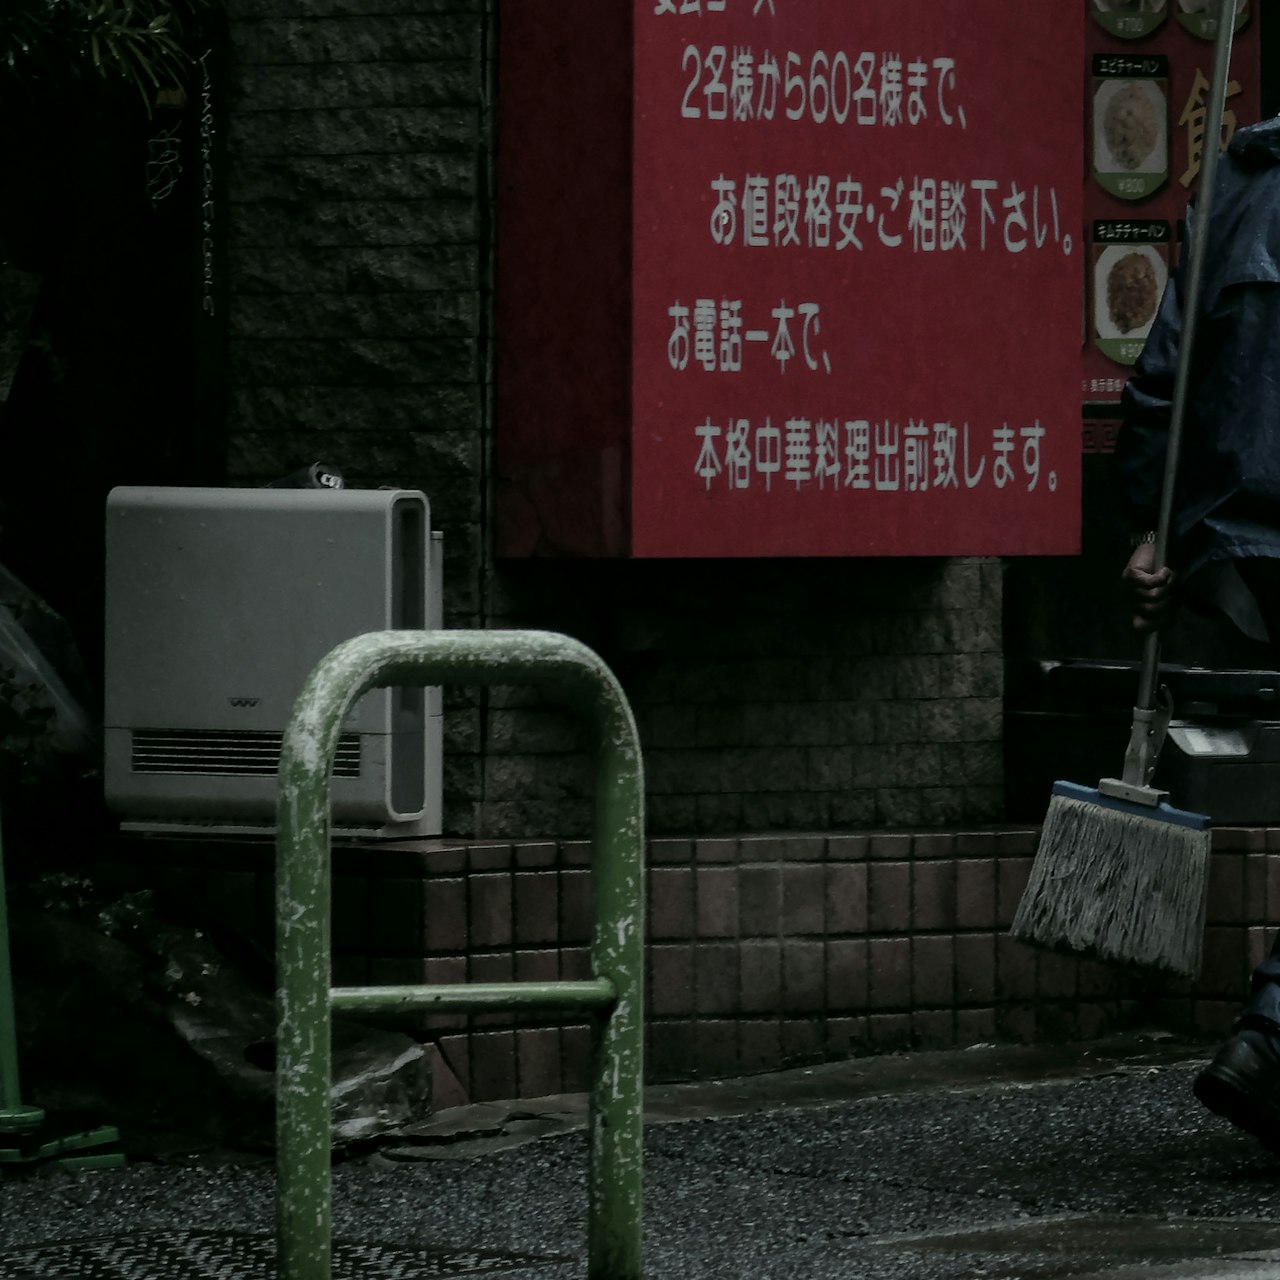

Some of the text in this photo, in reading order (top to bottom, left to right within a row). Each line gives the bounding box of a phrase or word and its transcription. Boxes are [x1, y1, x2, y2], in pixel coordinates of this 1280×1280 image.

[680, 44, 967, 129] 2名様から60名様まで、
[1099, 58, 1161, 75] エビチャーハン
[709, 174, 1073, 256] お値段格安・ご相談下さい。
[1096, 222, 1166, 240] キムチチャーハン
[667, 297, 832, 375] お電話一本で、
[694, 415, 1057, 493] 本格中華料理出前致します。
